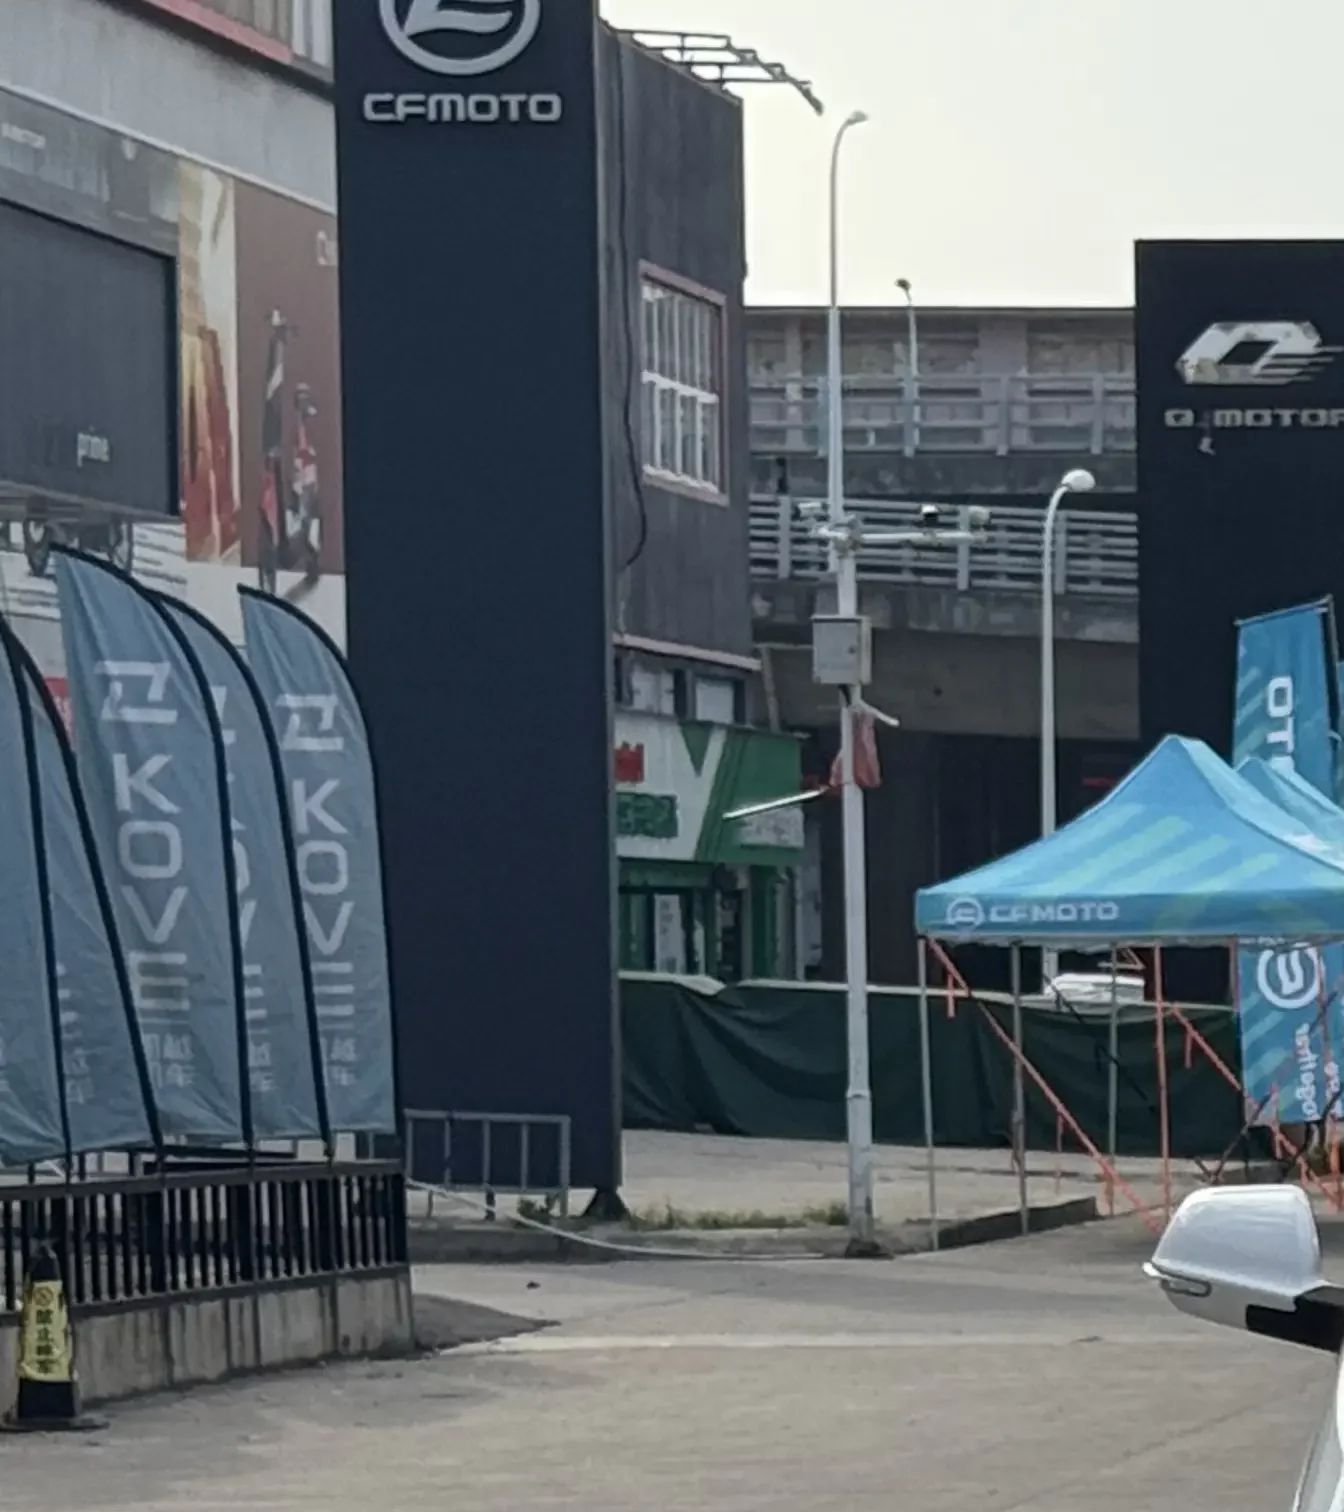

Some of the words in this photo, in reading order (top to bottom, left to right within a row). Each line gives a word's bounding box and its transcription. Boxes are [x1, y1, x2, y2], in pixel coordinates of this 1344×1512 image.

[363, 92, 562, 122] CFMOTO
[112, 752, 191, 1011] KOVE
[989, 901, 1120, 923] CFMOTO
